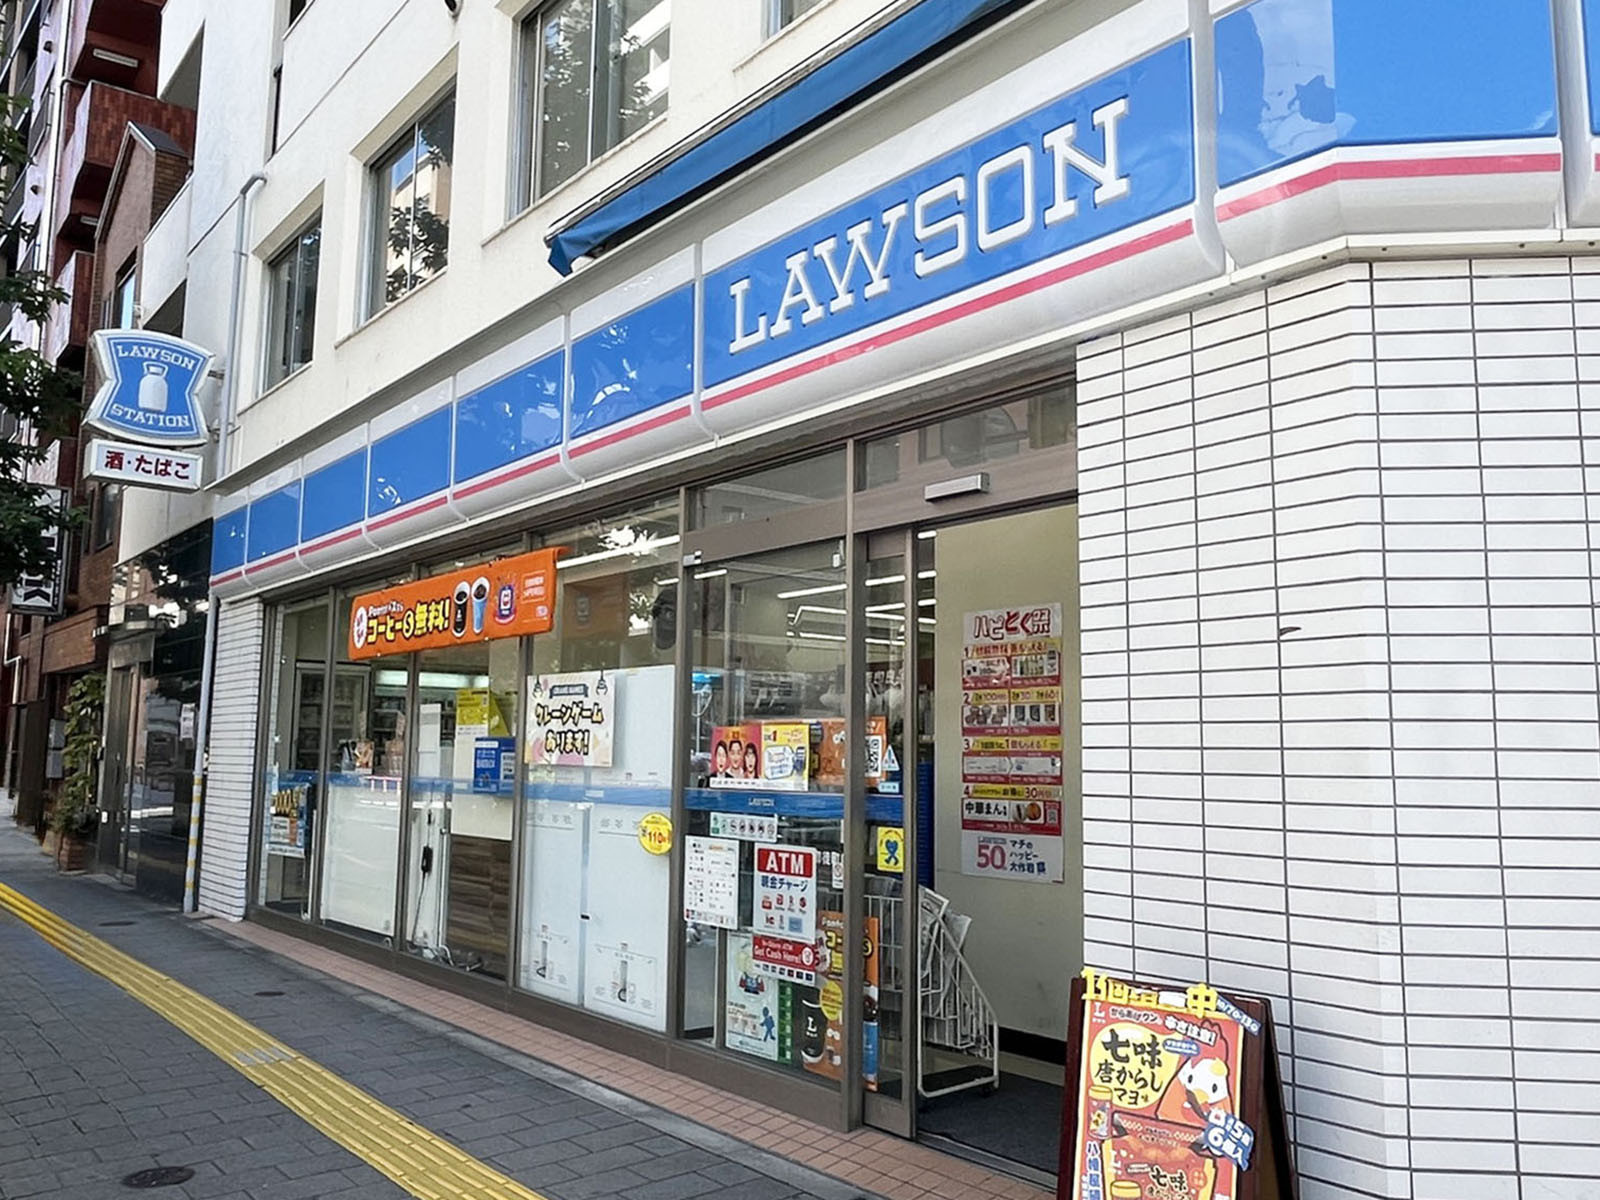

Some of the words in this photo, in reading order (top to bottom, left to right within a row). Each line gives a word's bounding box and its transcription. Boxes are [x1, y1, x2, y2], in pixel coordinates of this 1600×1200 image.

[729, 97, 1131, 355] LAWSON
[117, 344, 195, 371] LAWSON
[110, 403, 191, 428] STATION
[535, 700, 605, 726] クレーンゲーム
[544, 729, 590, 755] あります!
[766, 851, 805, 875] ATM
[977, 844, 1006, 870] 50
[1010, 850, 1039, 861] ハッピー
[761, 875, 809, 892] 現金チャージ
[766, 947, 782, 959] Cash
[1101, 1028, 1163, 1070] 七味
[1094, 1059, 1164, 1093] 唐からし
